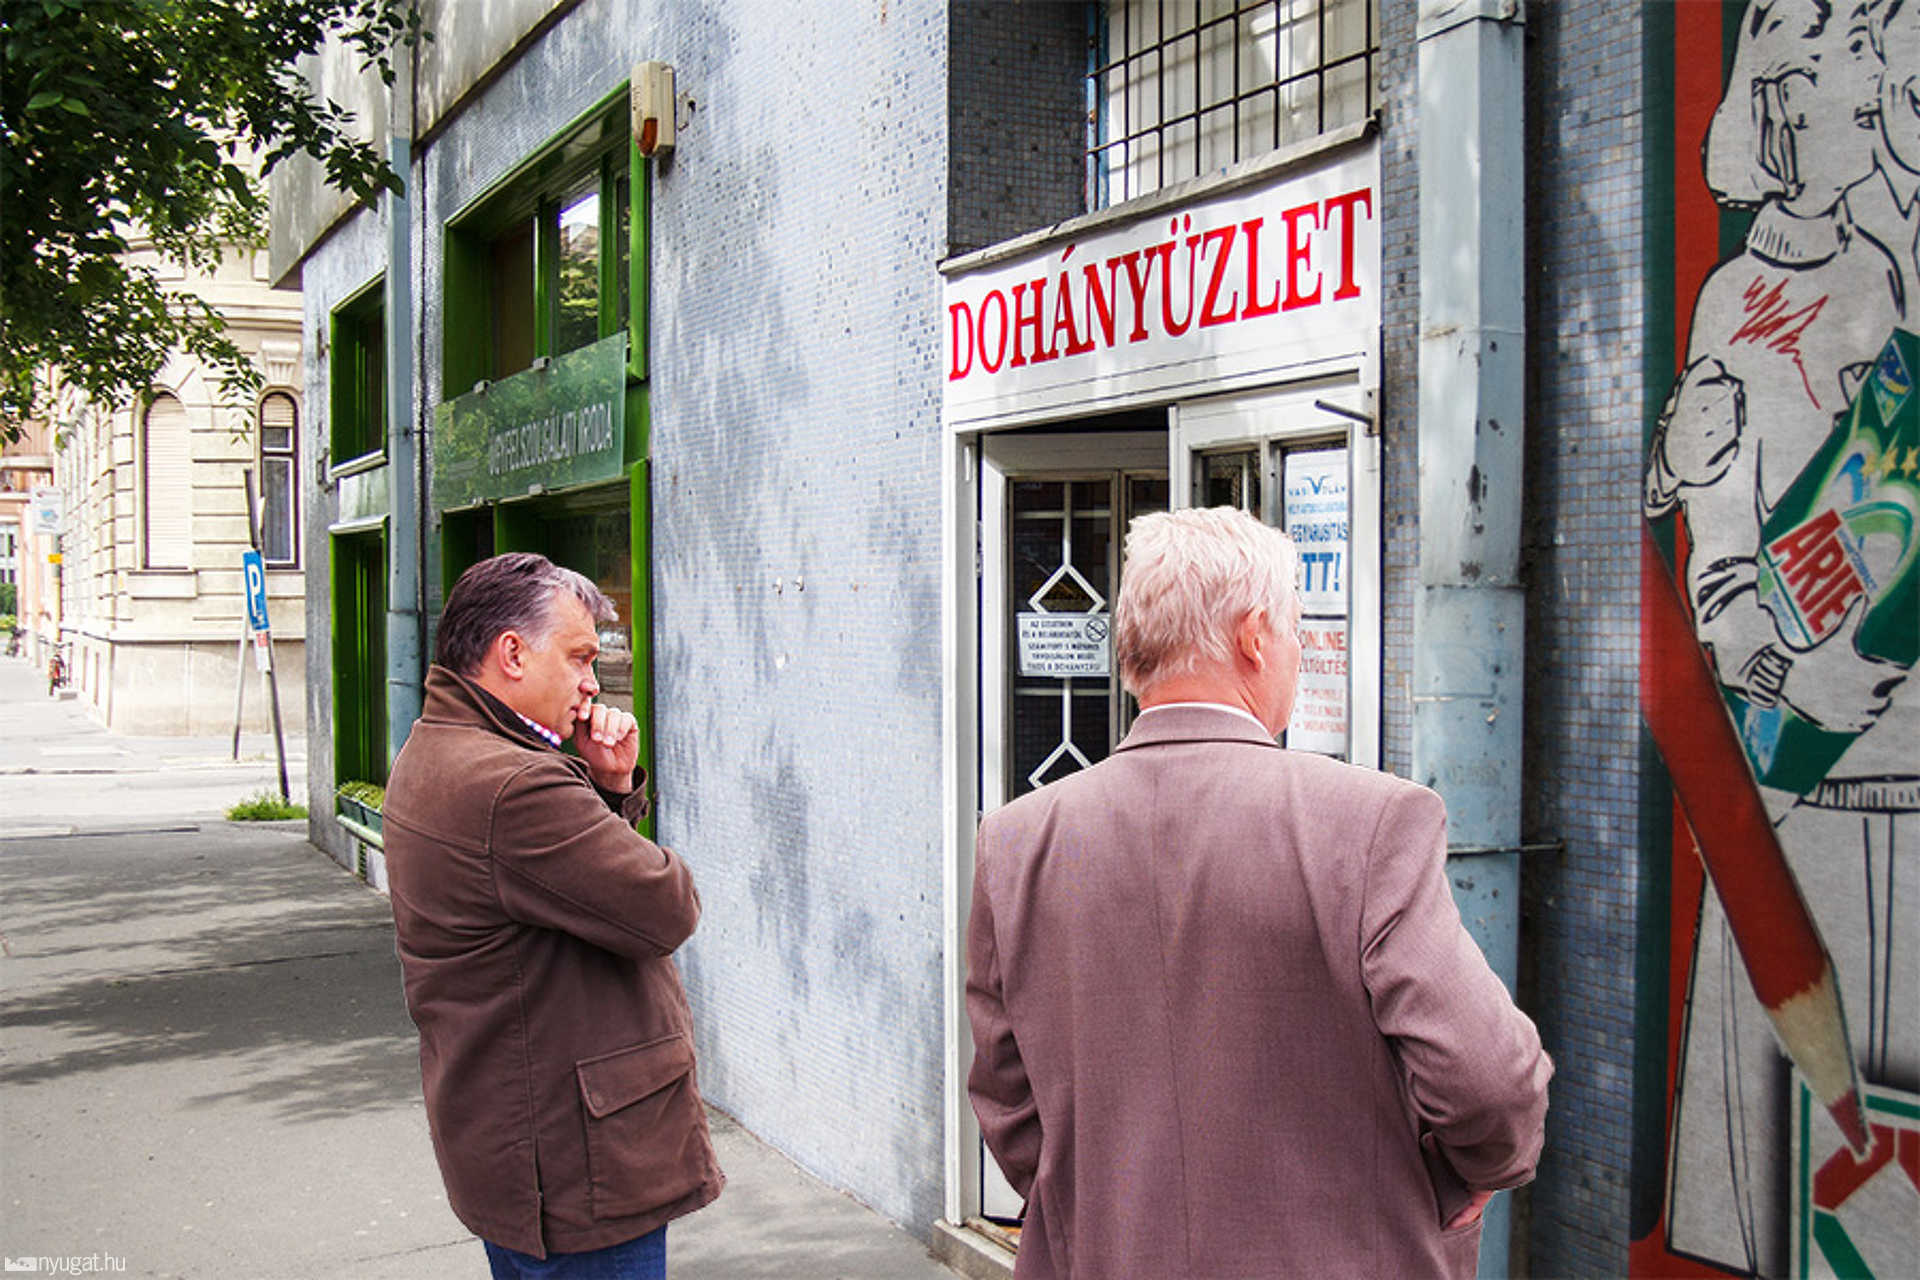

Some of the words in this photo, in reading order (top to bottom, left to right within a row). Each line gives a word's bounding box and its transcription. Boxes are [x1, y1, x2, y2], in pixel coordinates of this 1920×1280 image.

[948, 187, 1372, 382] DOHÁNYÜZLET
[247, 563, 262, 617] P
[1298, 551, 1342, 592] TT!
[1298, 630, 1347, 651] ONLINE
